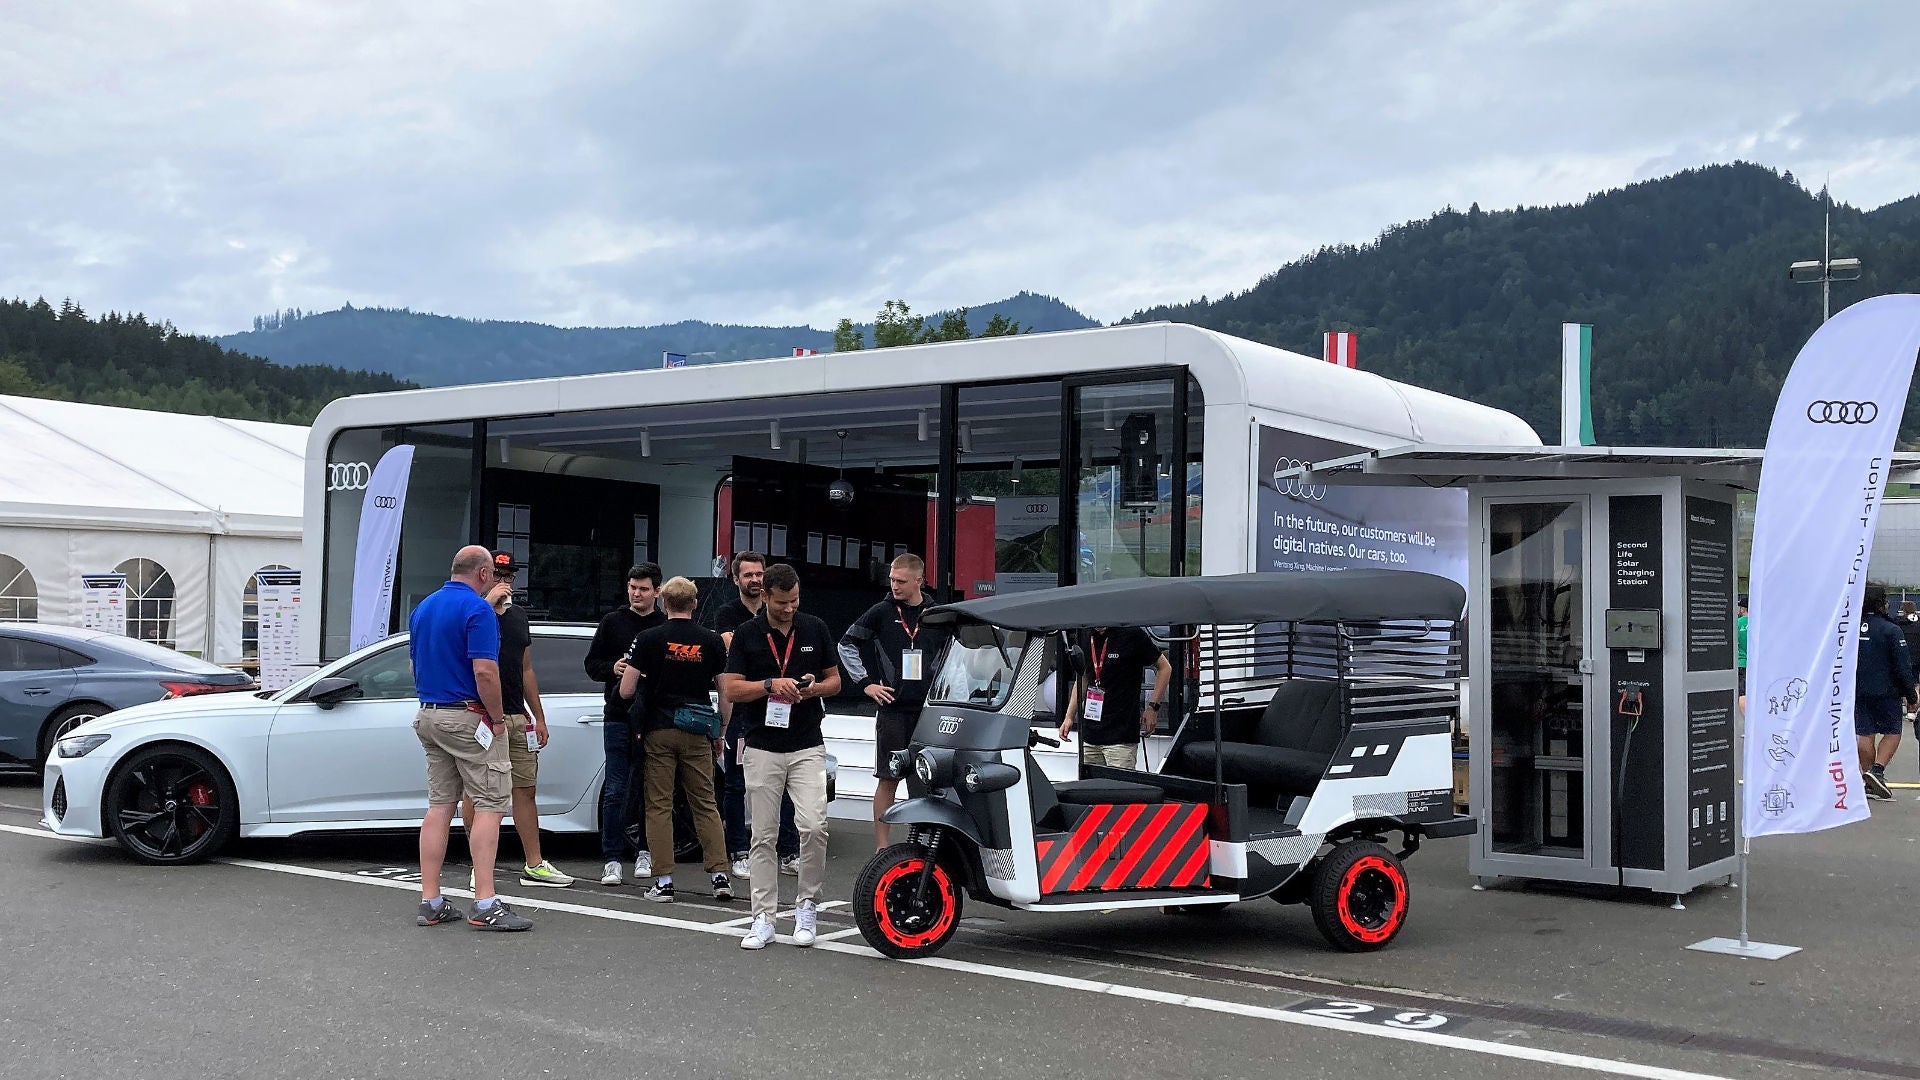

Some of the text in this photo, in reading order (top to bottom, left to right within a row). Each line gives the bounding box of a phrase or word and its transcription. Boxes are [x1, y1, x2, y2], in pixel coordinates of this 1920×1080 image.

[1274, 511, 1436, 547] In the future, our customers will be
[1273, 534, 1408, 564] digital natives. Our cars, too.
[1617, 541, 1648, 549] Second
[1617, 550, 1633, 558] Life
[1617, 559, 1640, 567] Solar
[1617, 568, 1655, 577] Charging
[1617, 578, 1648, 586] Station
[1828, 761, 1848, 810] Audi
[1301, 1001, 1448, 1029] 29
